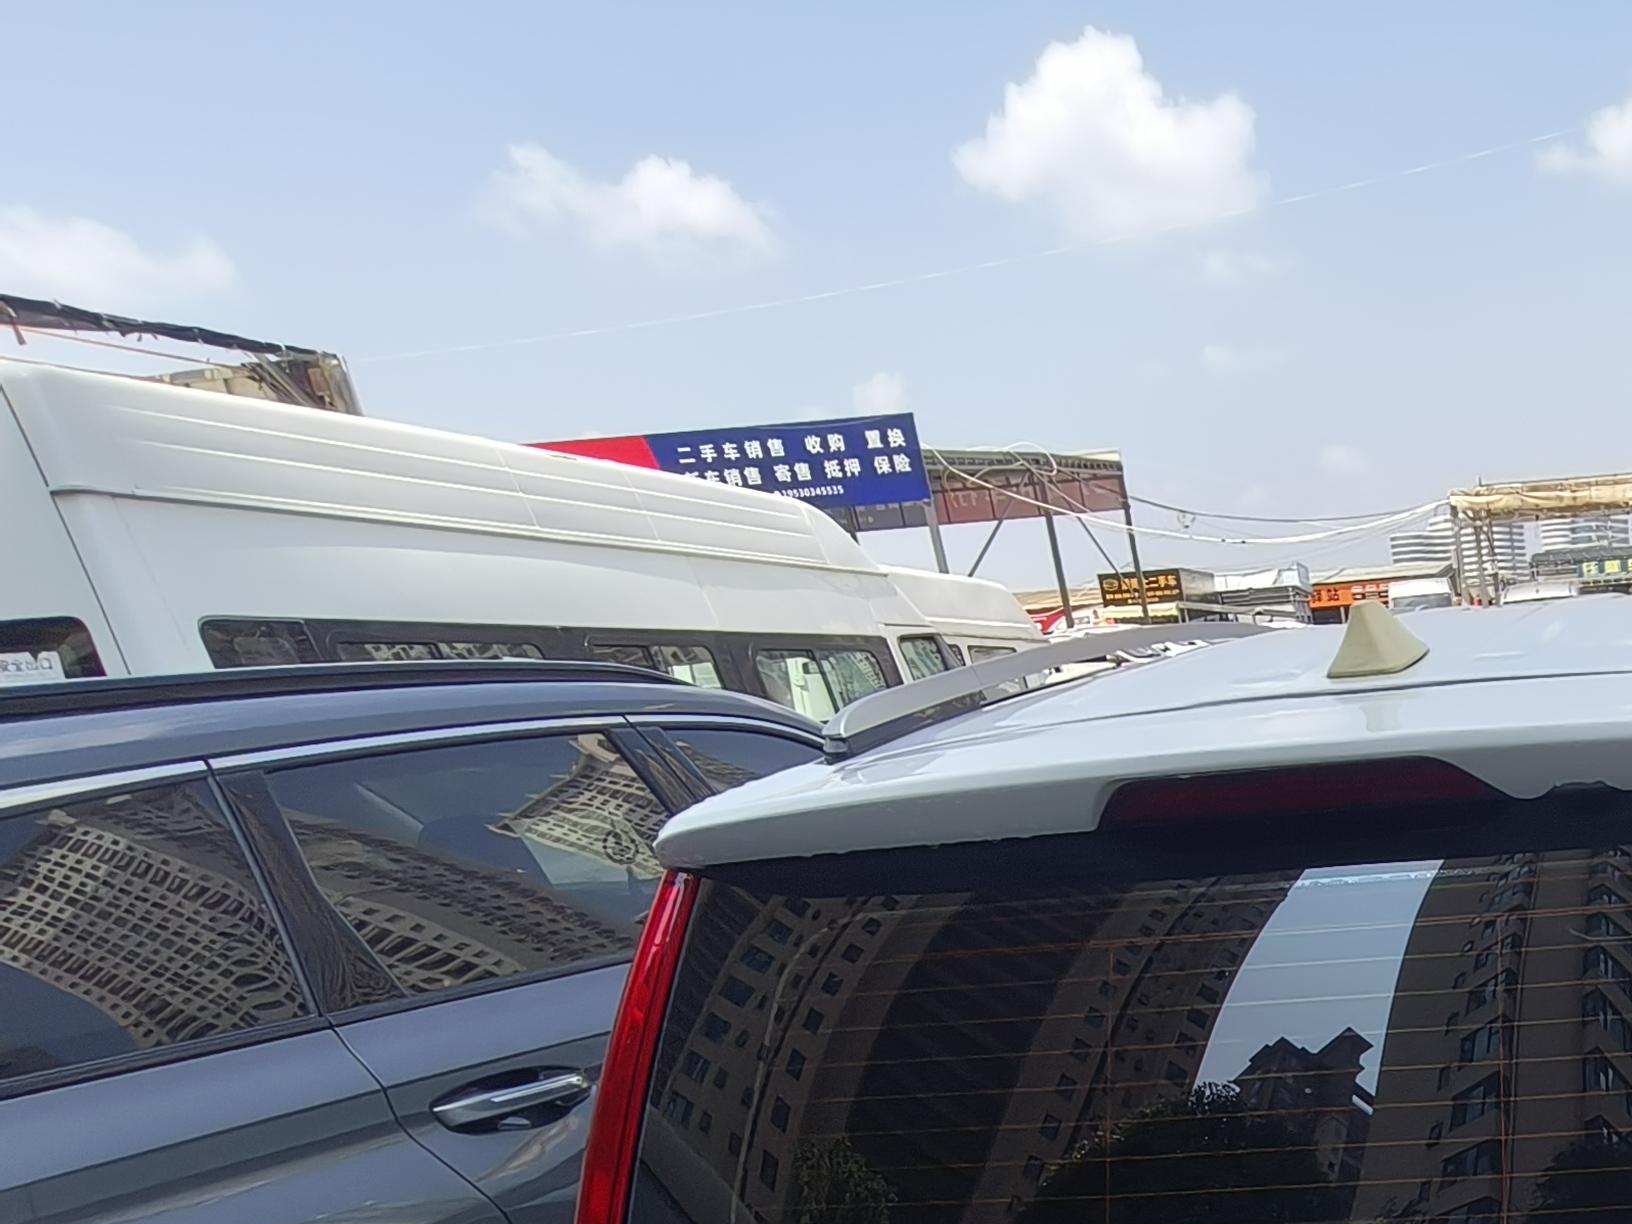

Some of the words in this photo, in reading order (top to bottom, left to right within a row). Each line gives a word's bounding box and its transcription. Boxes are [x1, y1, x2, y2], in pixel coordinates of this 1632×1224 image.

[677, 438, 785, 463] 二手车销售
[804, 433, 845, 454] 收购
[864, 428, 906, 449] 置换
[773, 462, 812, 482] 寄售
[824, 458, 861, 479] 抵押
[873, 454, 912, 475] 保险
